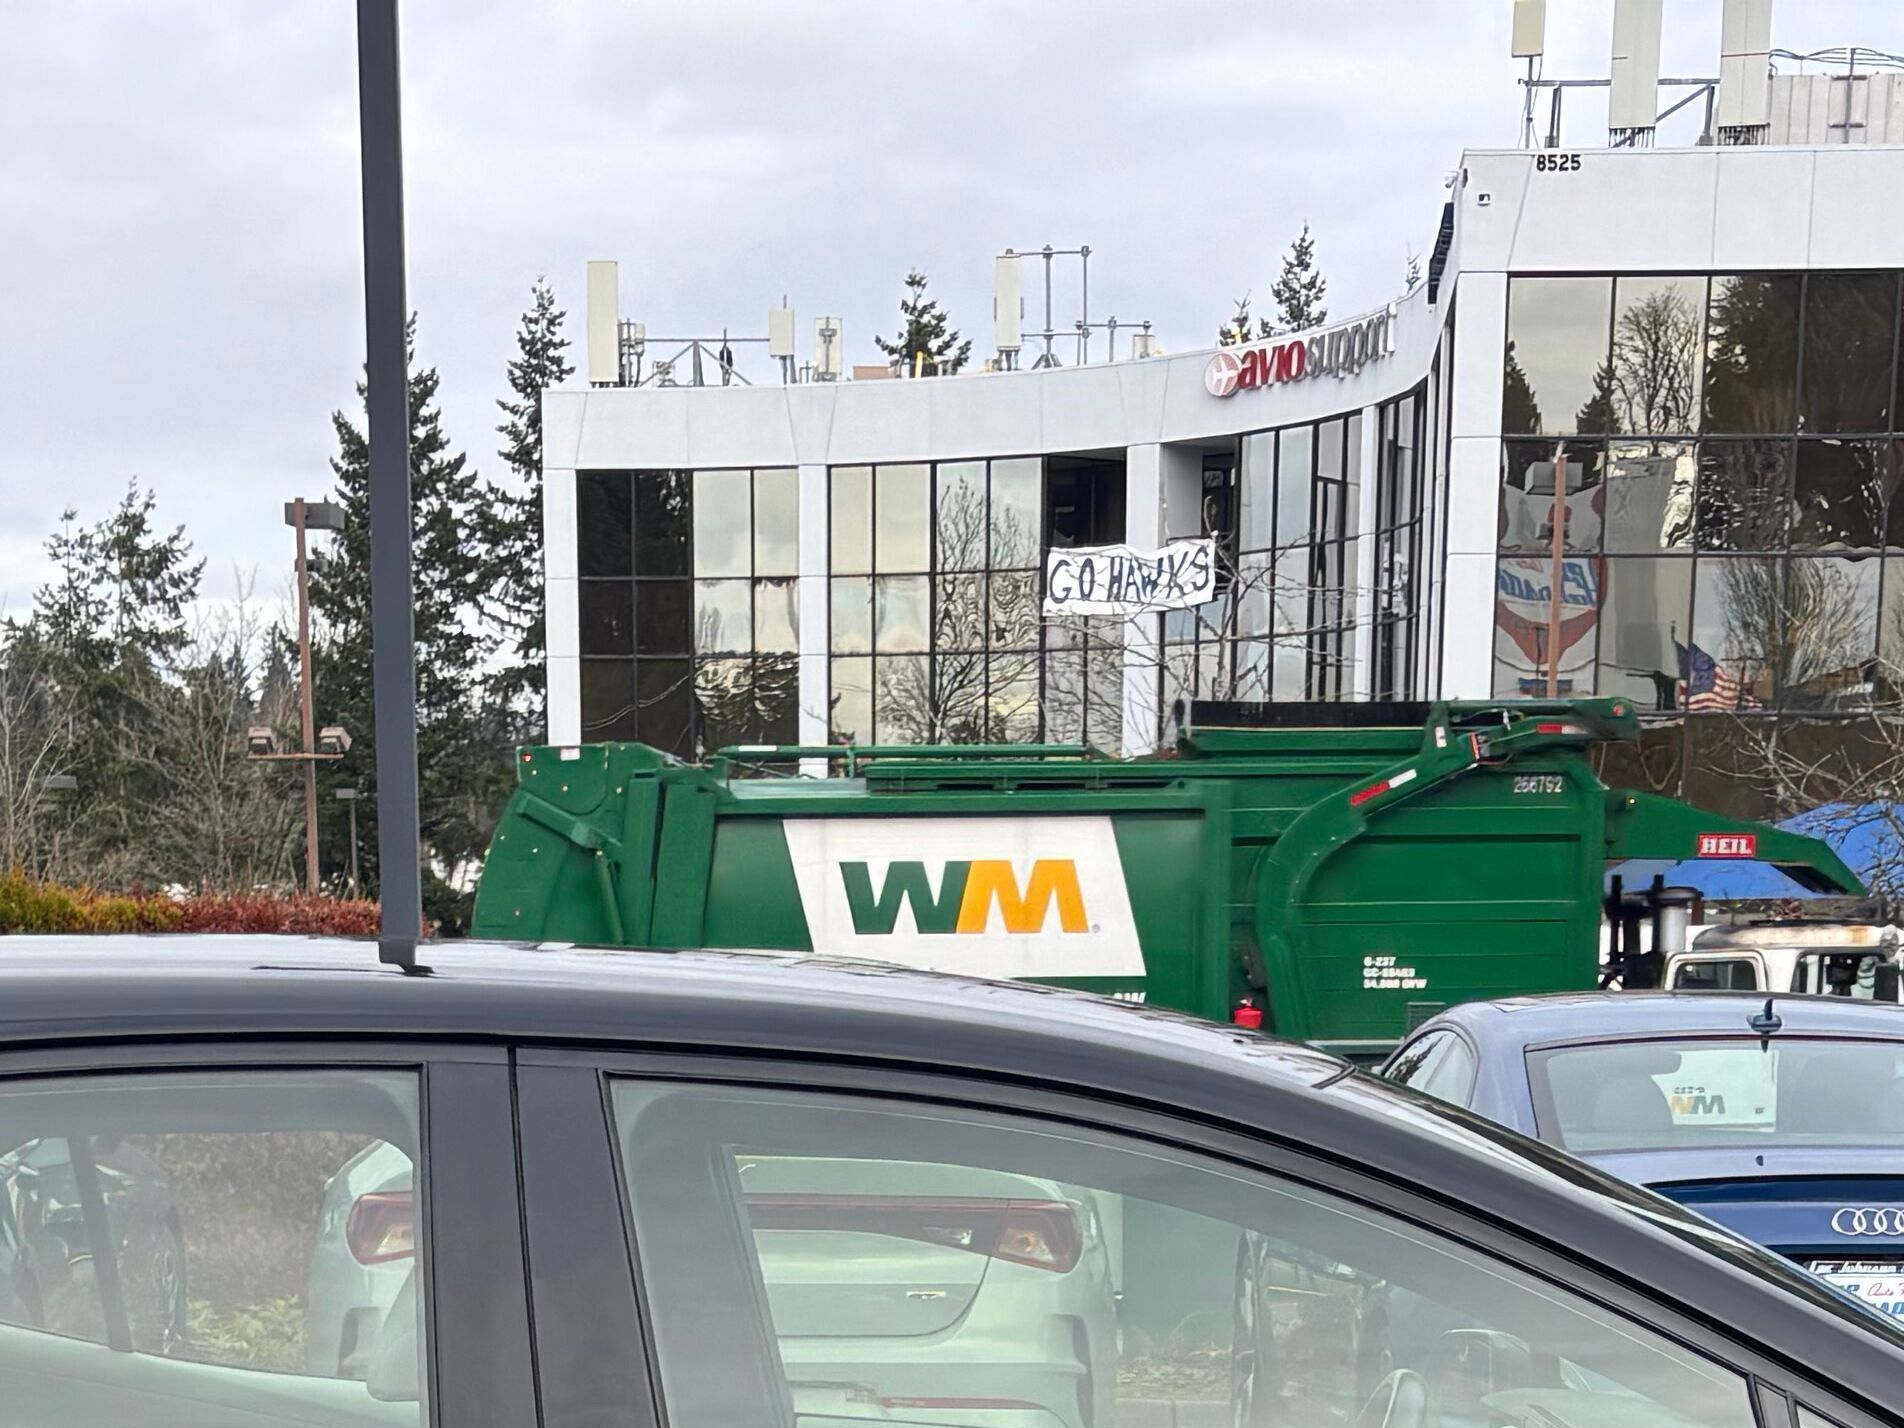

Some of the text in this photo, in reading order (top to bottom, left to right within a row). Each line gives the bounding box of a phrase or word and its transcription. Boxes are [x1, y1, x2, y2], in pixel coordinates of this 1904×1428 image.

[1536, 154, 1582, 172] 8525
[1049, 545, 1210, 604] GO HAWKS
[1700, 838, 1753, 854] HEIL
[838, 858, 1090, 935] WM
